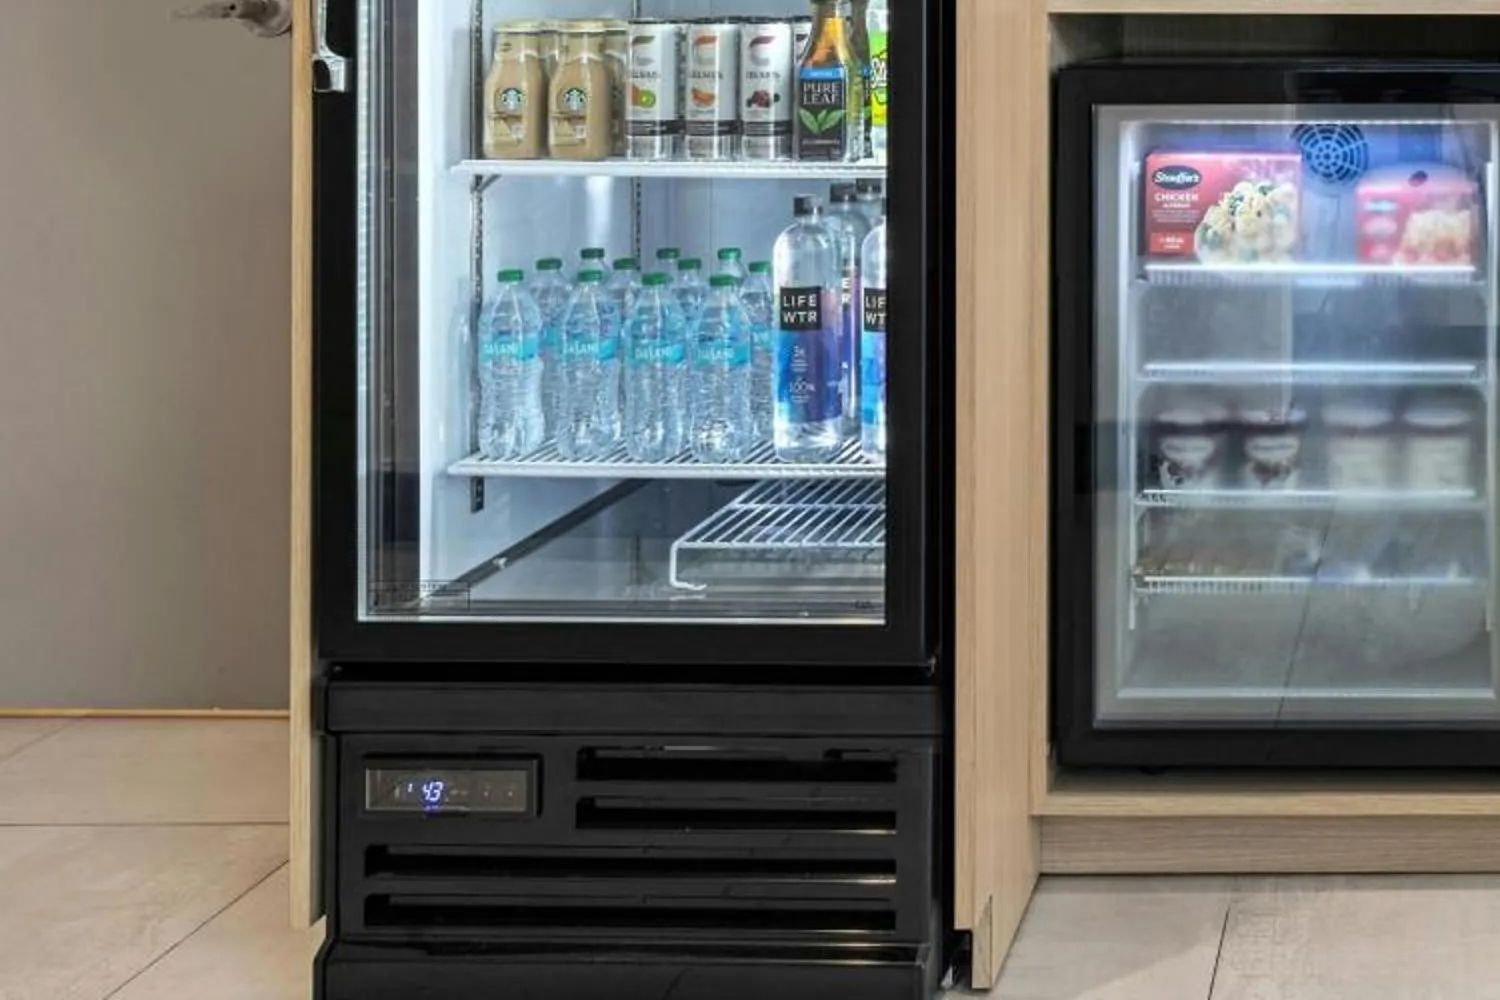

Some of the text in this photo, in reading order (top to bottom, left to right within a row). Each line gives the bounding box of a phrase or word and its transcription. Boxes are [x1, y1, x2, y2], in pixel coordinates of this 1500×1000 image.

[803, 82, 840, 93] PURE
[803, 93, 840, 105] LEAF
[783, 294, 817, 308] LIFE
[865, 295, 887, 309] LIF
[783, 311, 818, 324] WTR
[865, 313, 887, 325] WT
[422, 781, 444, 801] 43
